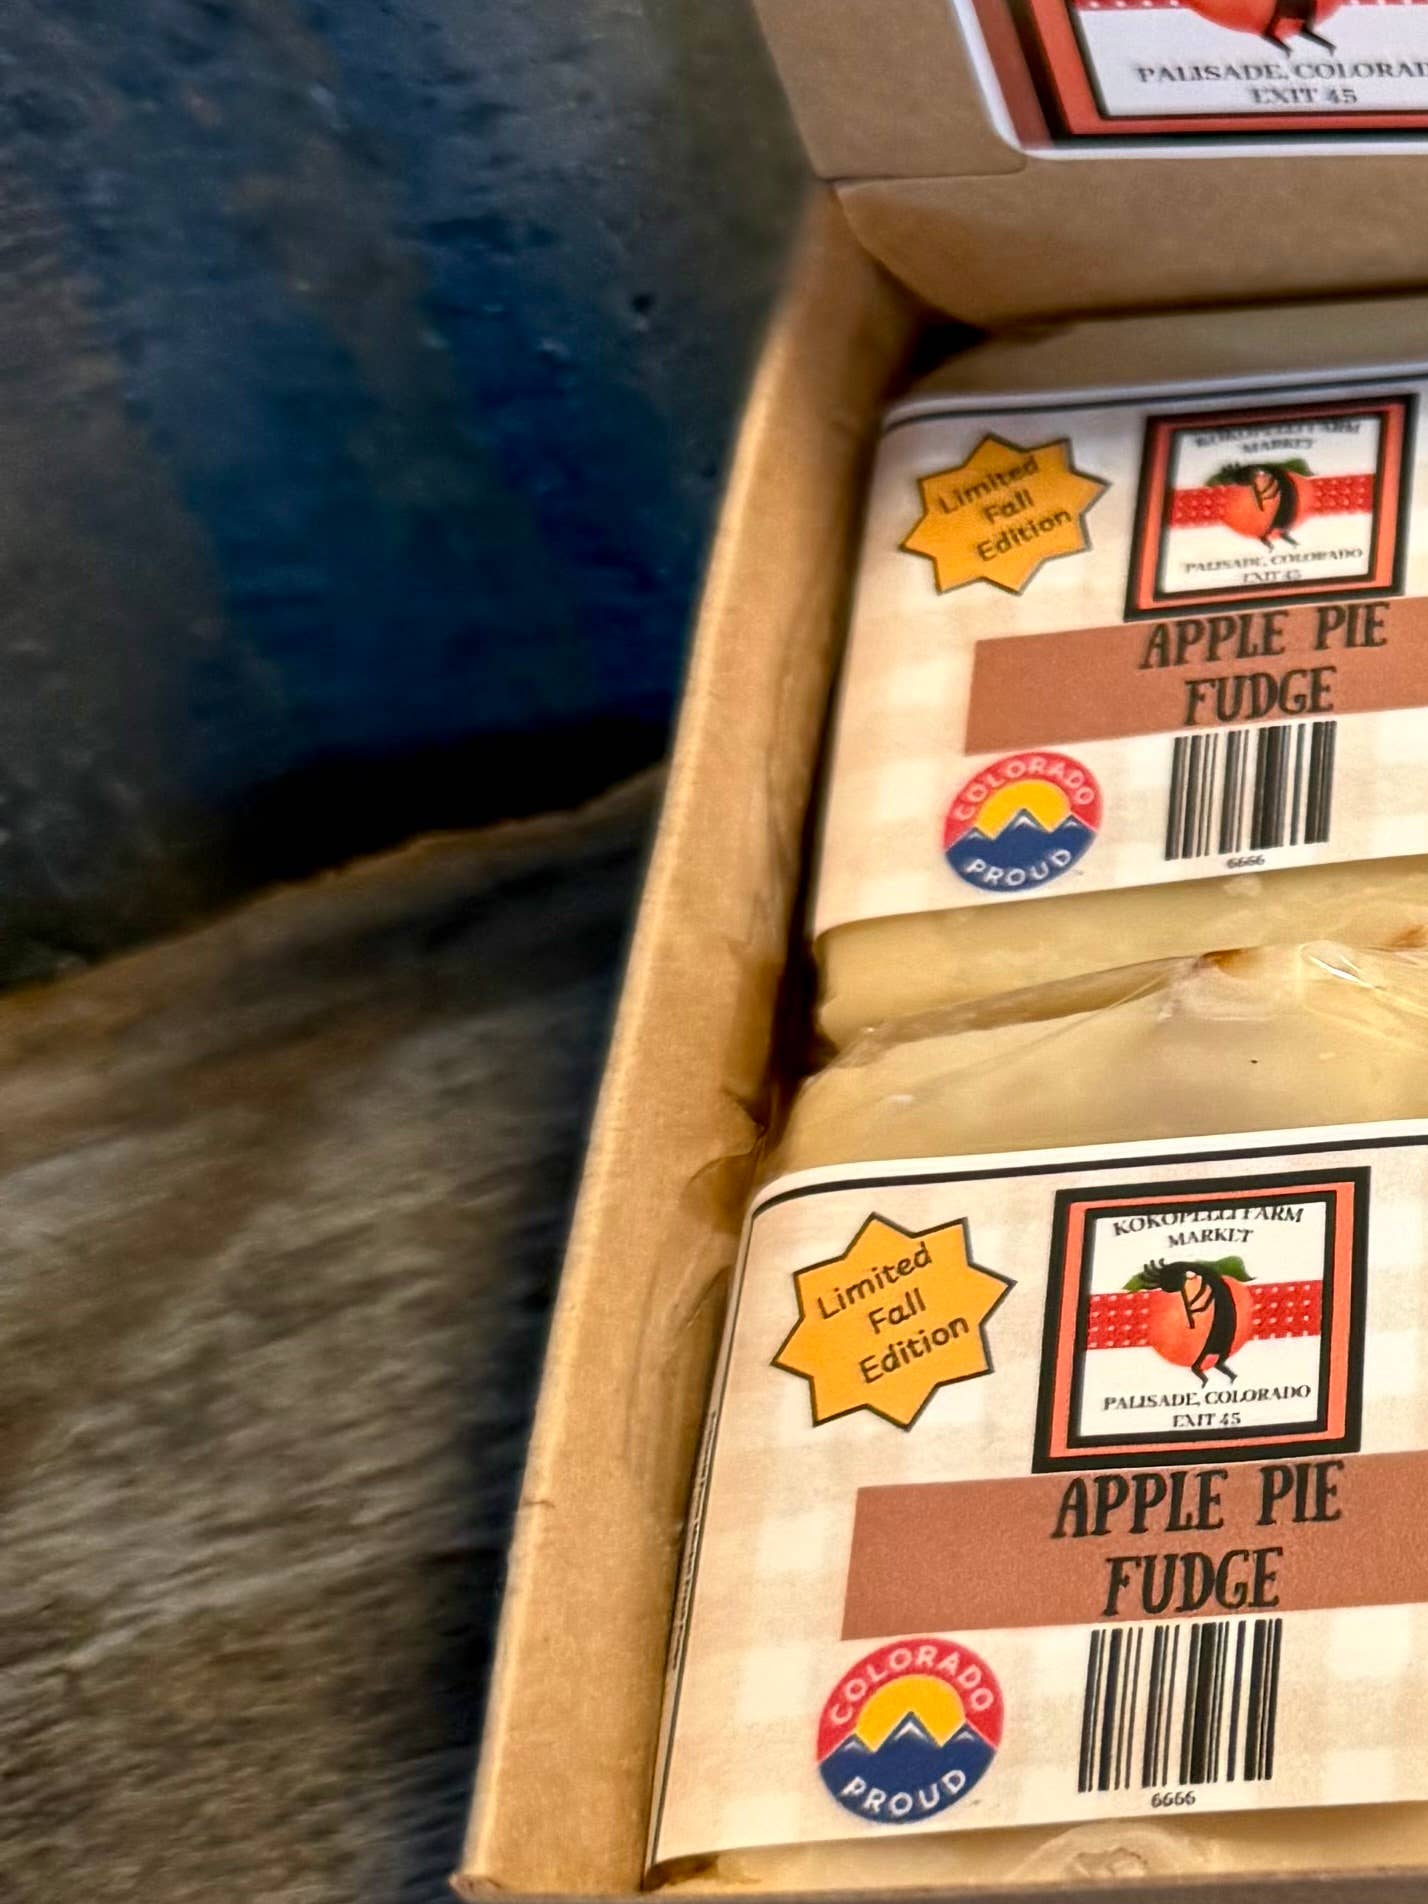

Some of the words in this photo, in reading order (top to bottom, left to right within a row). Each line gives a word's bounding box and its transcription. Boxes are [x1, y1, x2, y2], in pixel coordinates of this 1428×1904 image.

[1251, 86, 1316, 106] EXIT
[936, 456, 1040, 516] Limited
[983, 488, 1035, 524] Fall
[977, 507, 1072, 563] Edition
[1139, 606, 1290, 670] APPLE
[1315, 600, 1392, 652] PIE
[1183, 666, 1337, 727] FUDGE
[954, 756, 1095, 823] COLORADO
[965, 848, 1072, 887] PROUD
[1168, 1228, 1254, 1248] MARKET
[817, 1243, 932, 1319] Limited
[867, 1288, 927, 1335] Fall
[860, 1316, 969, 1383] Edition
[1204, 1384, 1311, 1405] COLORADO
[1050, 1469, 1228, 1539] APPLE
[1257, 1460, 1344, 1527] PIE
[1103, 1546, 1283, 1618] FUDGE
[830, 1644, 994, 1728] COLORADO
[842, 1767, 967, 1817] PROUD
